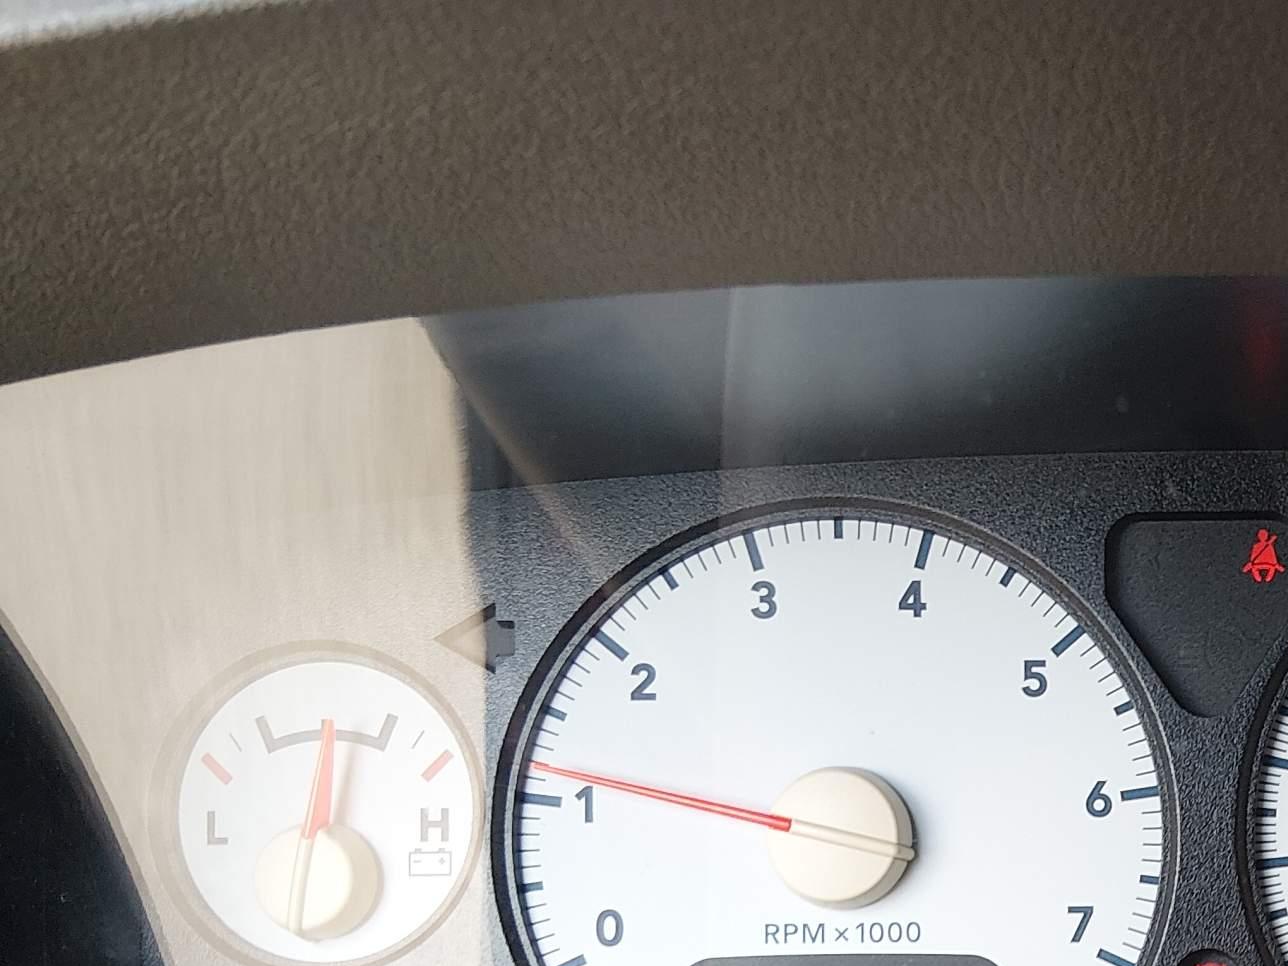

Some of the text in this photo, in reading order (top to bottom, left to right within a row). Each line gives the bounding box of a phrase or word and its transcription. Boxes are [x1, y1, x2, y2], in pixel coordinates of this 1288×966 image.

[751, 581, 777, 619] 3
[899, 581, 926, 617] 4
[631, 663, 656, 700] 2
[1022, 660, 1047, 697] 5
[574, 785, 594, 823] 1
[1086, 781, 1112, 817] 6
[207, 811, 228, 845] L
[420, 808, 449, 842] H
[596, 909, 623, 946] 0
[765, 923, 824, 944] RPM
[1068, 906, 1093, 943] 7
